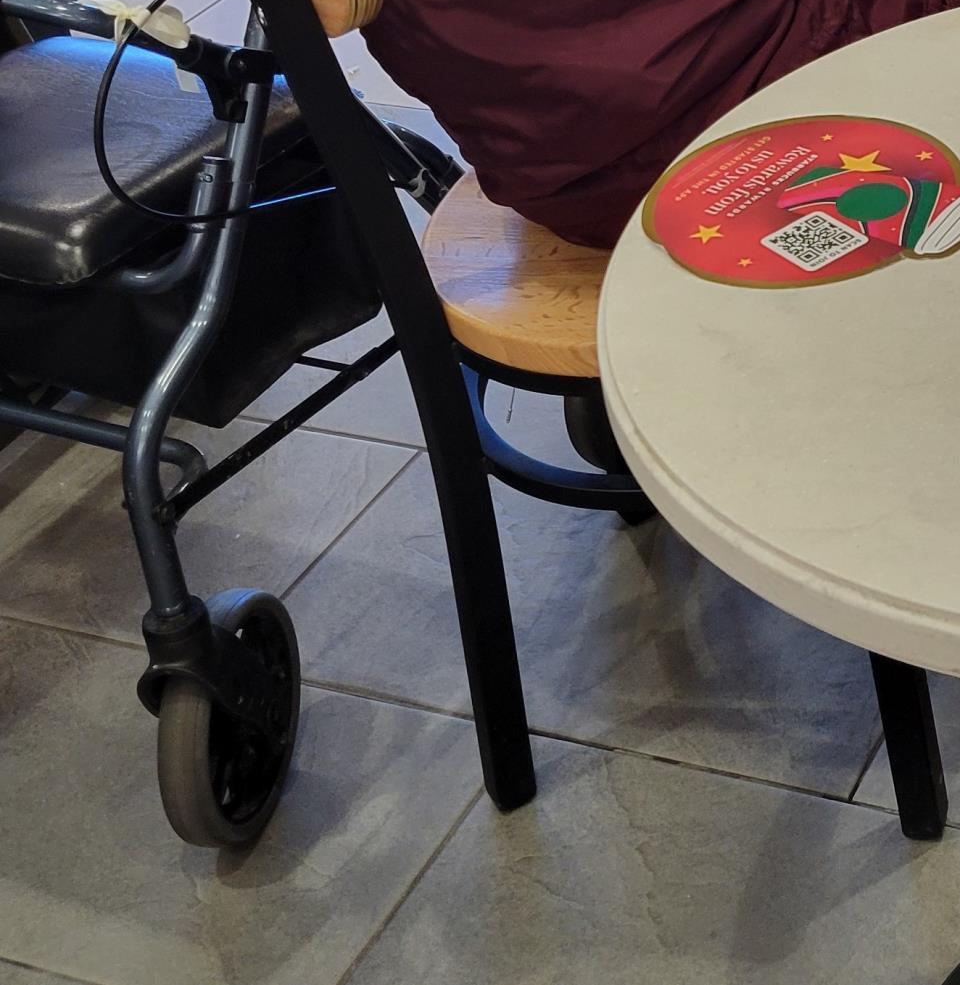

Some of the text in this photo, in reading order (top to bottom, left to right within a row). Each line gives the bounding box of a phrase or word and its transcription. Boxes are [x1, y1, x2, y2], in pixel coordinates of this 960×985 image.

[756, 136, 771, 147] GET
[720, 147, 755, 171] STARTED
[743, 146, 812, 189] Rewards
[751, 150, 774, 163] us
[735, 162, 758, 175] to
[702, 172, 740, 194] you.
[726, 154, 818, 217] STARBUCKS REWARDS
[704, 188, 751, 215] from
